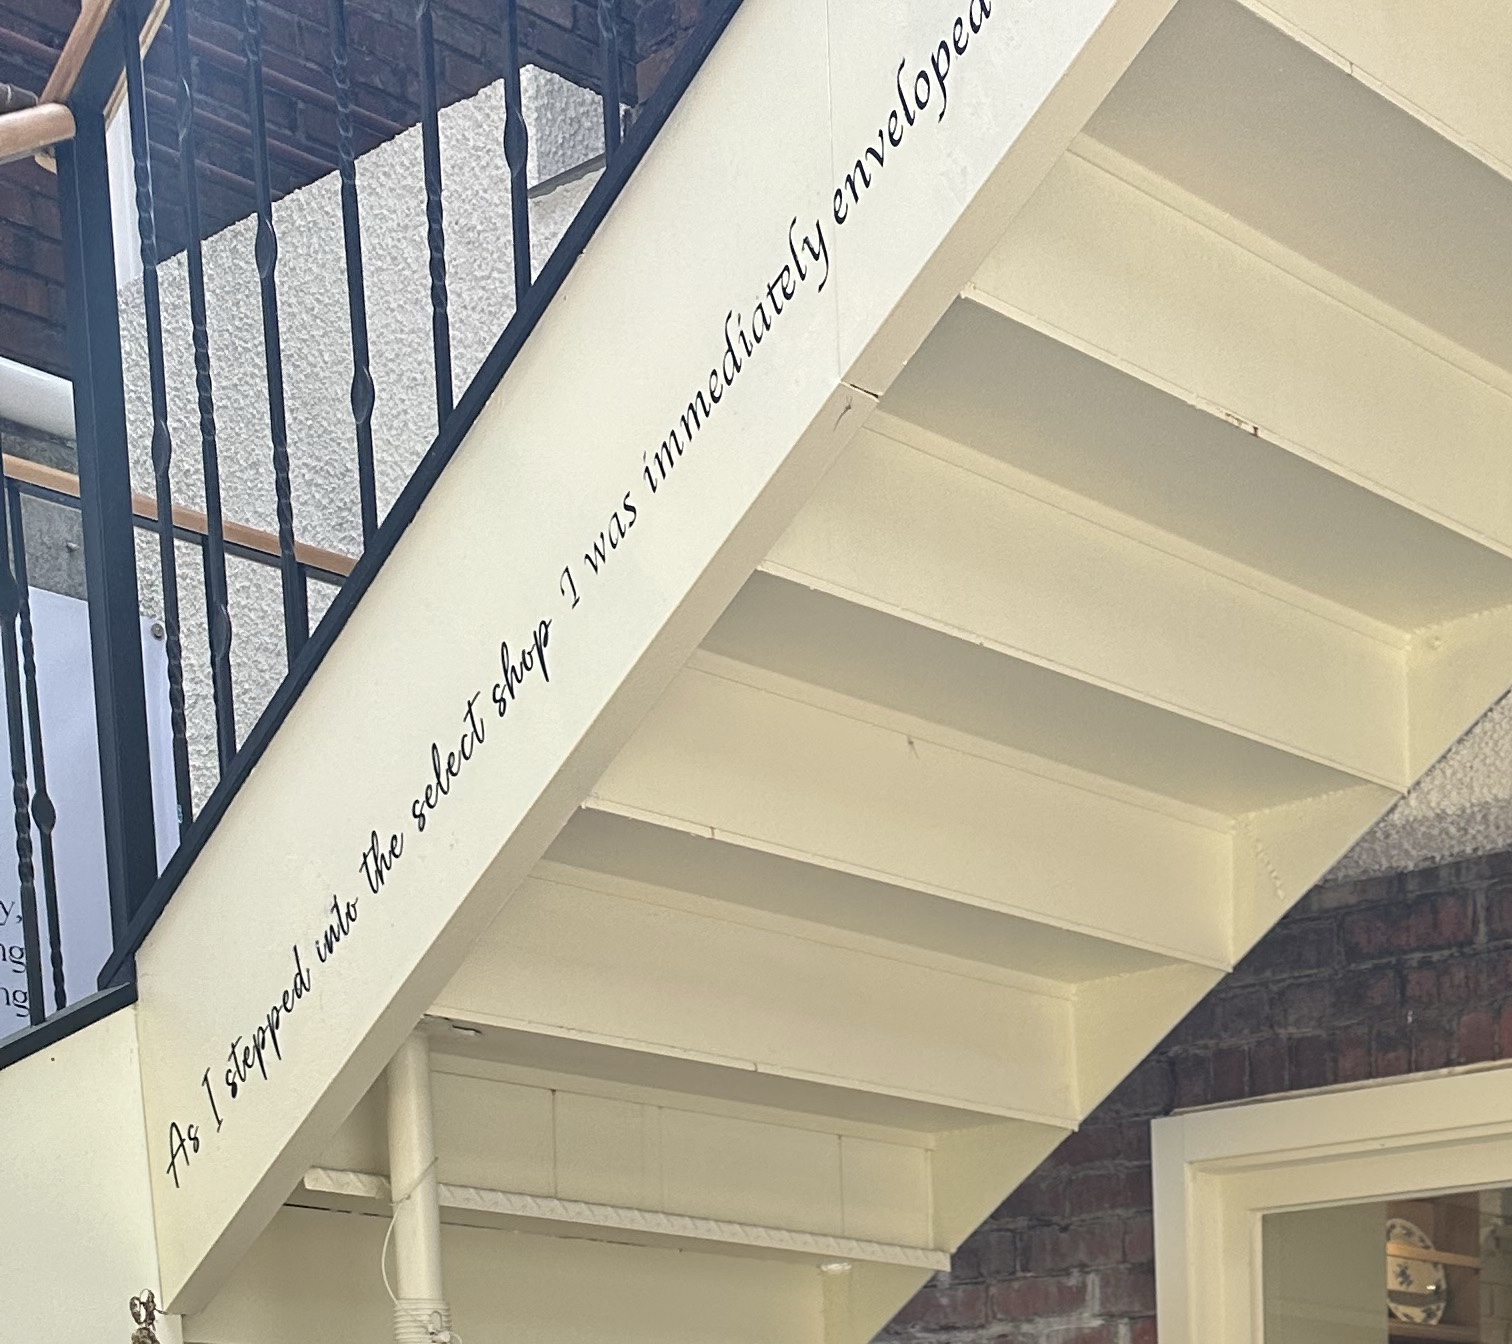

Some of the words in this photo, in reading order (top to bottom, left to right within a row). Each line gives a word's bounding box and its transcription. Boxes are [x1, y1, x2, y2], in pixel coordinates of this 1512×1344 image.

[165, 1121, 200, 1189] As
[200, 1066, 224, 1134] I
[224, 943, 312, 1100] stepped
[314, 893, 359, 964] into
[358, 829, 404, 895] the
[411, 690, 485, 833] select
[491, 618, 553, 718] shop
[559, 565, 581, 610] I
[583, 490, 638, 576] was
[642, 215, 830, 494] immediately
